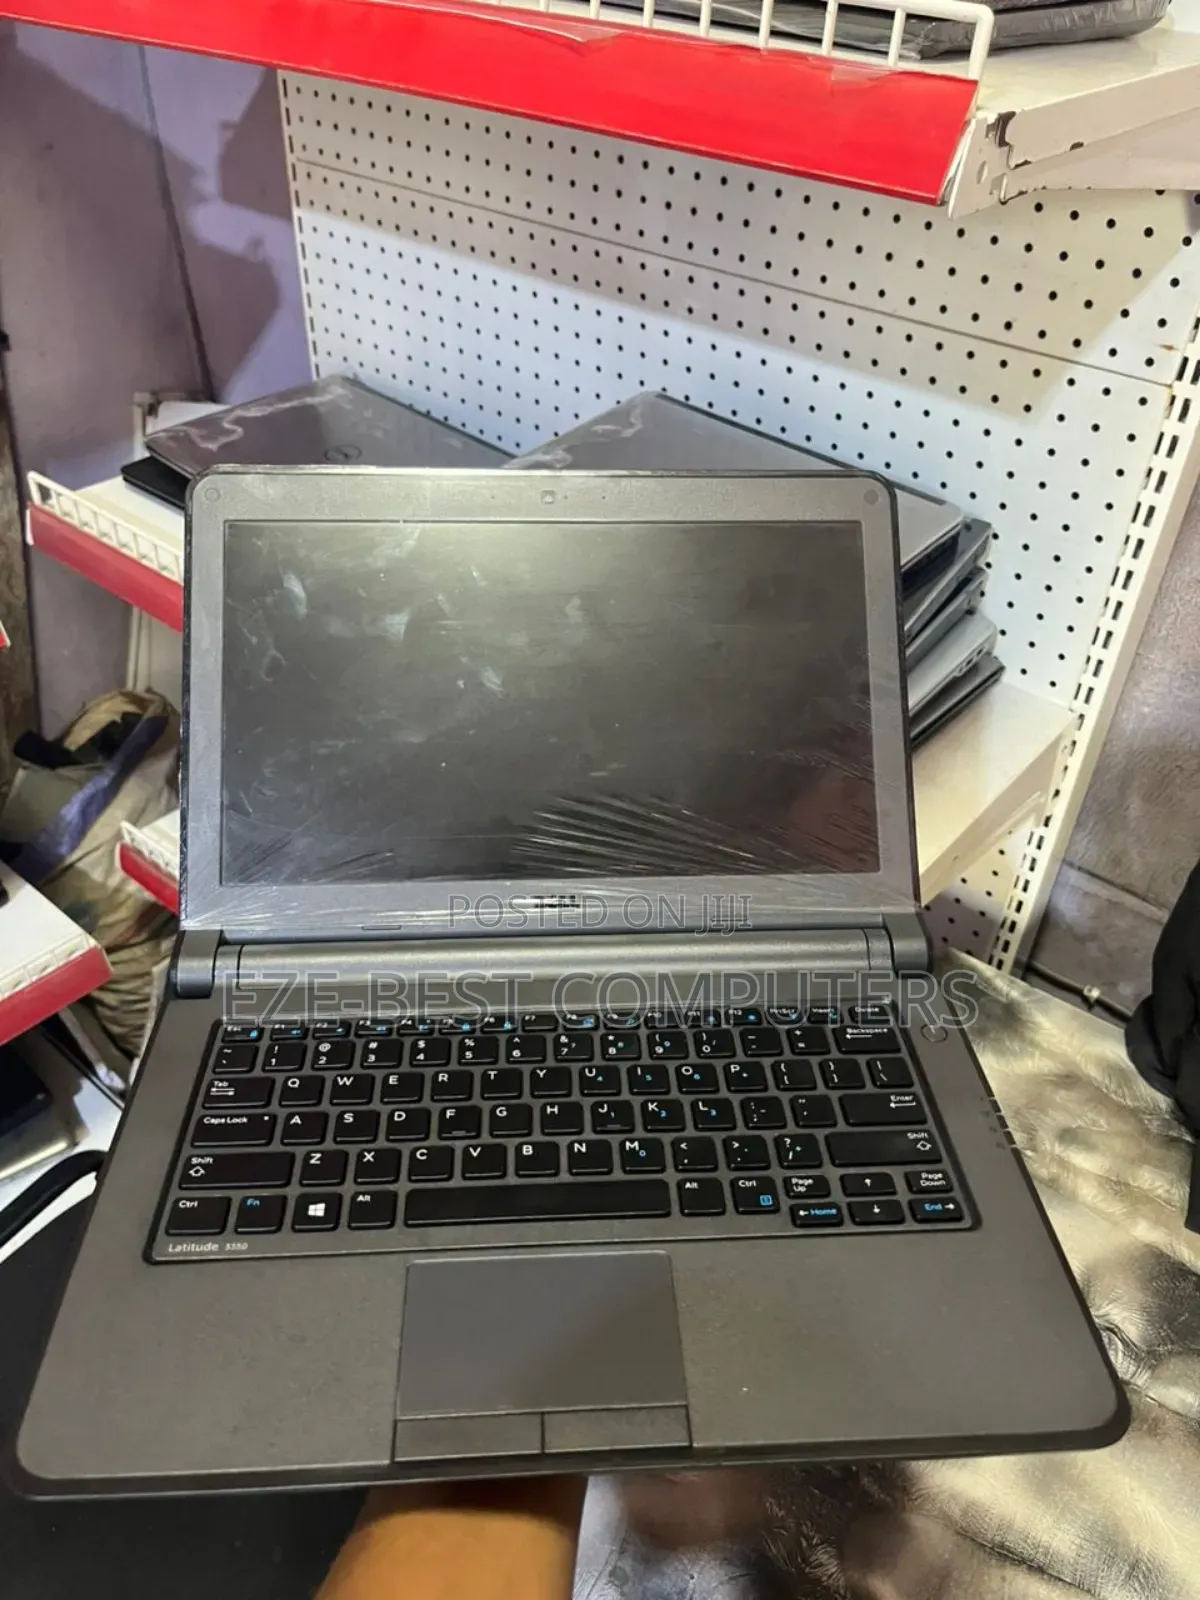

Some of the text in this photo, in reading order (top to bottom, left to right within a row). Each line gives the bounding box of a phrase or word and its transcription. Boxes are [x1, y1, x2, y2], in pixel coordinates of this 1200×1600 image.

[416, 1052, 425, 1061] 4
[465, 1051, 473, 1060] 5
[512, 1049, 521, 1058] 6
[319, 1056, 327, 1065] 2
[367, 1054, 376, 1063] 3
[585, 1068, 596, 1077] U
[681, 1066, 693, 1075] O
[730, 1064, 740, 1073] P
[438, 1073, 448, 1082] R
[487, 1071, 498, 1080] T
[536, 1069, 547, 1078] Y
[288, 1078, 300, 1088] Q
[337, 1076, 353, 1086] W
[389, 1075, 399, 1085] E
[546, 1105, 559, 1115] H
[599, 1104, 608, 1113] J
[648, 1102, 659, 1111] K
[699, 1101, 709, 1111] L
[394, 1111, 406, 1121] D
[446, 1109, 456, 1119] F
[496, 1107, 508, 1117] G
[203, 1116, 248, 1124] Caps Lock
[290, 1115, 302, 1124] A
[343, 1113, 354, 1122] S
[522, 1145, 534, 1155] B
[574, 1143, 586, 1153] N
[625, 1141, 639, 1151] M
[416, 1150, 428, 1160] C
[469, 1147, 481, 1157] V
[191, 1156, 214, 1164] Shift
[310, 1154, 322, 1164] Z
[363, 1152, 375, 1162] X
[921, 1172, 943, 1180] Page
[685, 1181, 698, 1189] Alt
[739, 1180, 757, 1188] Ctrl
[791, 1178, 813, 1186] Page
[920, 1179, 946, 1187] Down
[179, 1200, 198, 1209] Ctrl
[924, 1203, 942, 1211] End
[810, 1208, 837, 1216] Home
[168, 1242, 220, 1252] Latitude
